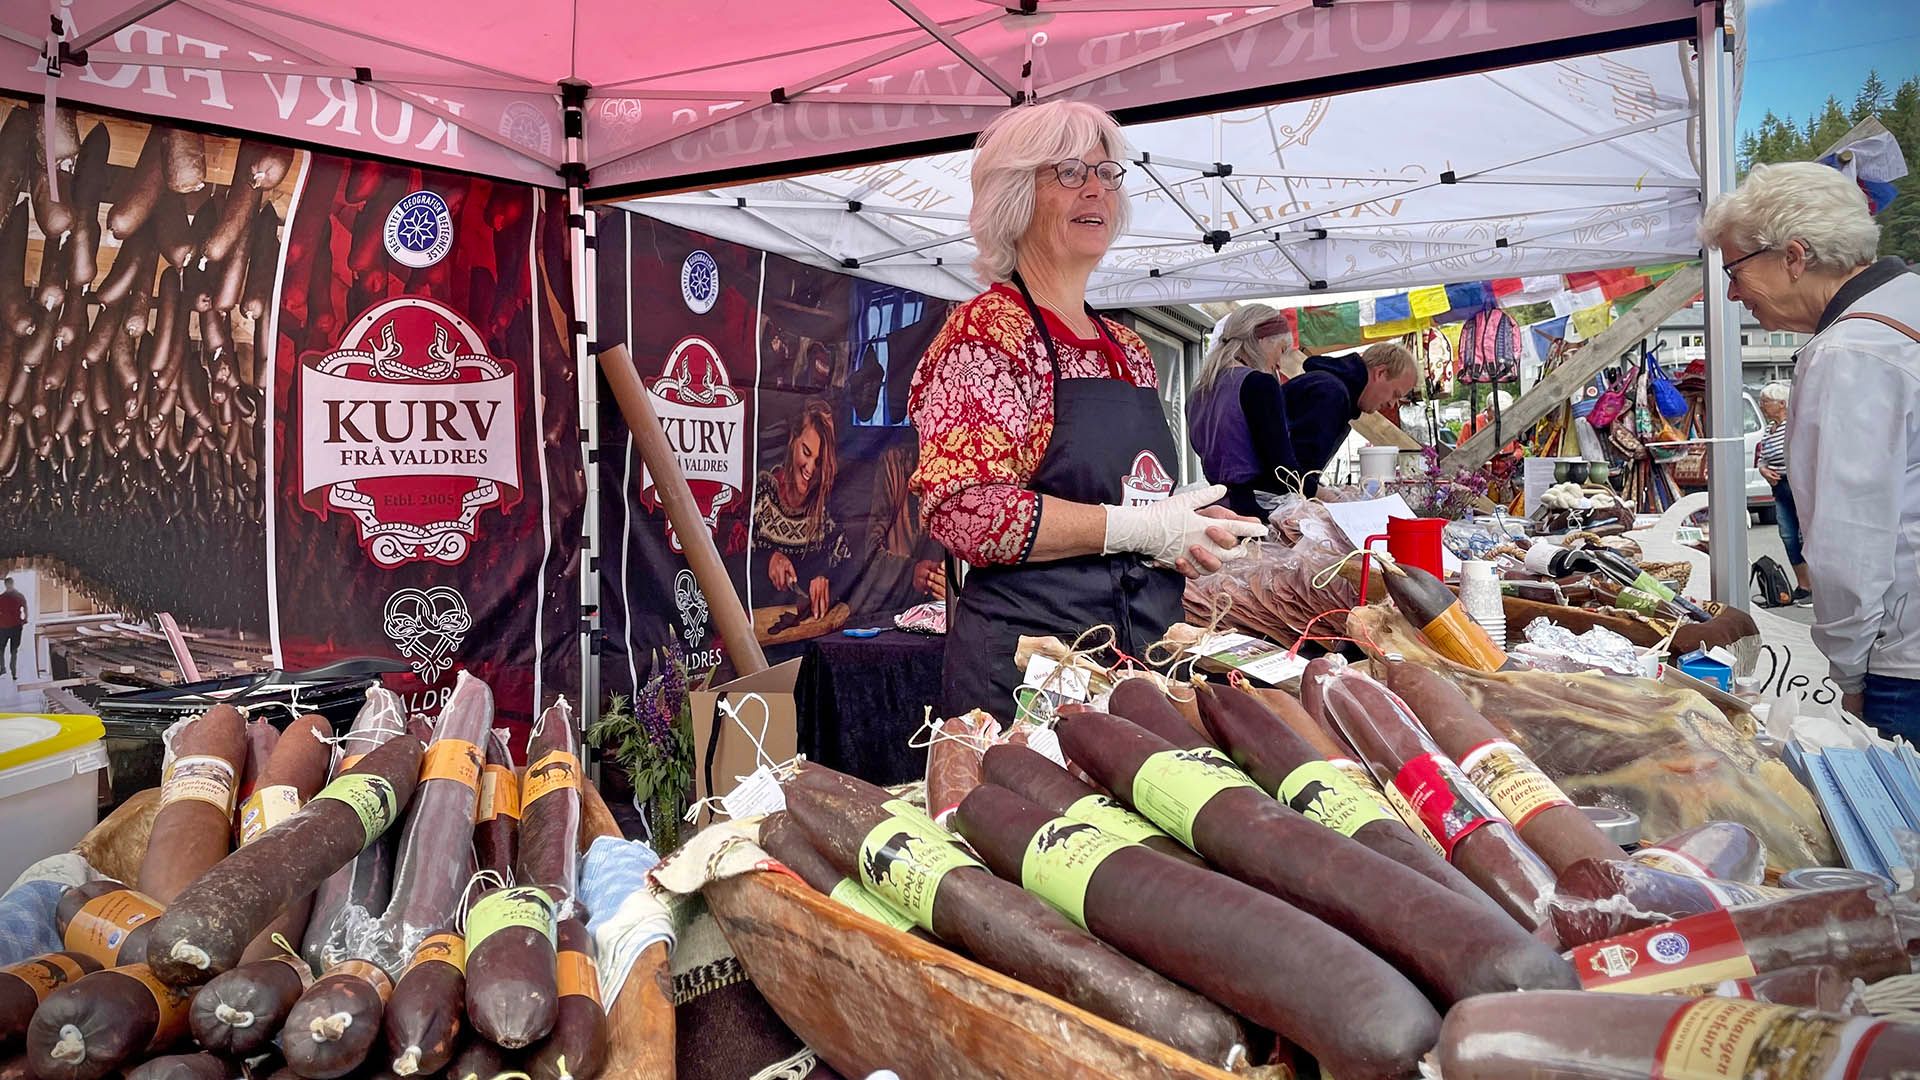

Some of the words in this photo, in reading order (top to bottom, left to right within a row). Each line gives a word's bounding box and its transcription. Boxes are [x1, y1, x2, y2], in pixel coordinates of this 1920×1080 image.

[402, 194, 444, 214] GEOGRAFISK
[387, 209, 402, 254] BESKYTTET
[426, 215, 450, 261] BETEGNELSE
[323, 399, 501, 443] KURV
[657, 416, 737, 454] KURV
[340, 446, 386, 465] FRÅ
[389, 448, 488, 465] VALDRES
[684, 458, 729, 472] VALDRES
[417, 493, 454, 506] 2005
